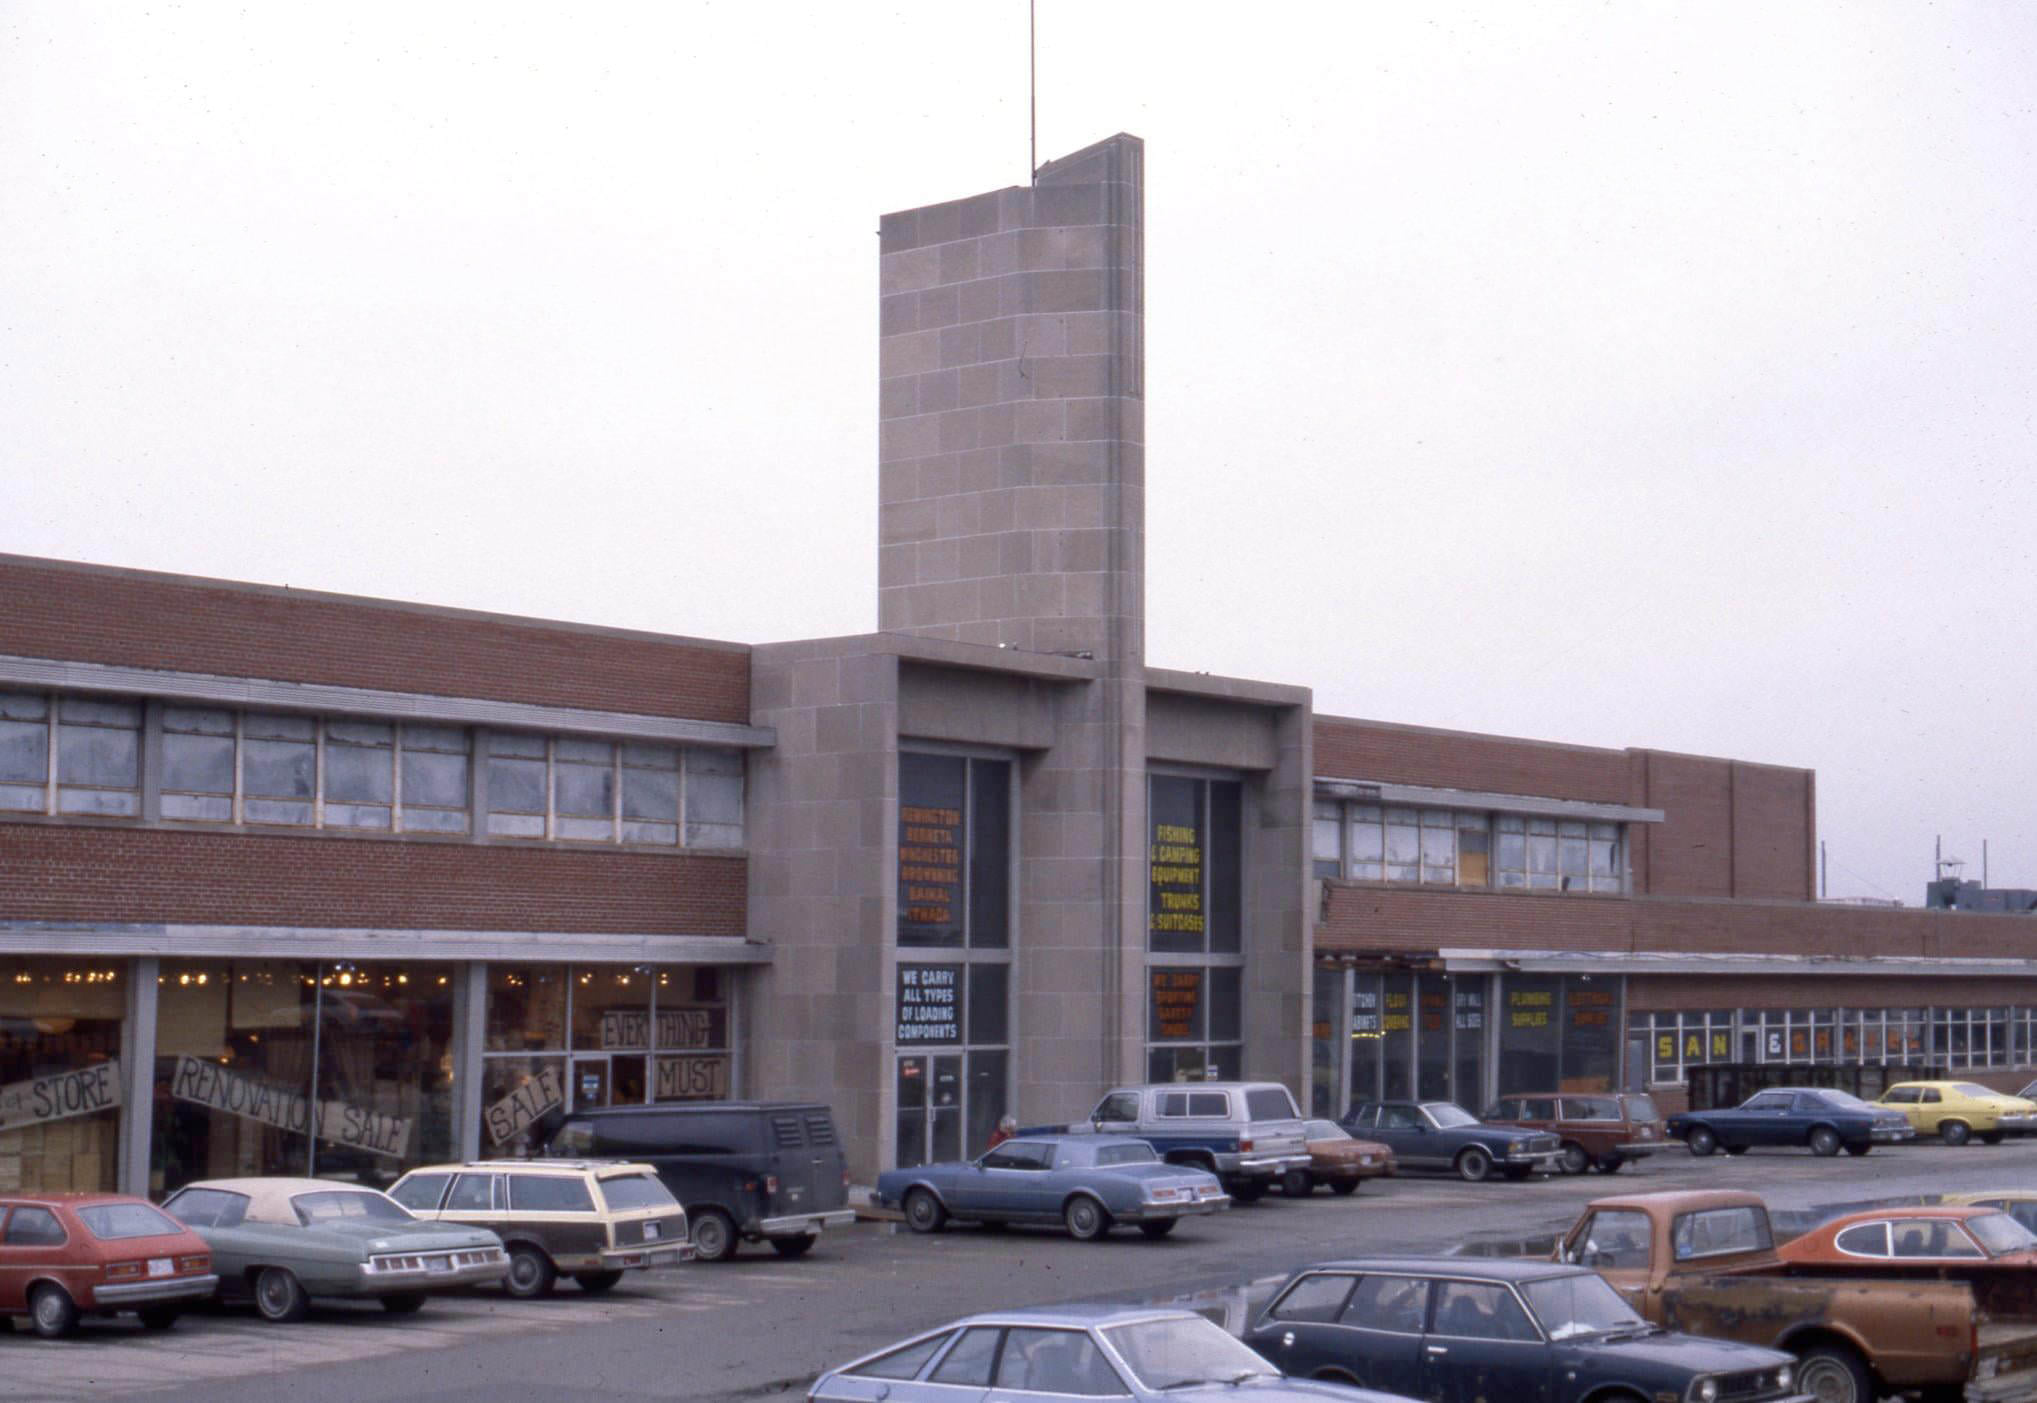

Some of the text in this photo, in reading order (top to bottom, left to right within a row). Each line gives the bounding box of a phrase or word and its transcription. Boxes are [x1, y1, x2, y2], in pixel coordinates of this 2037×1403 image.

[1157, 824, 1195, 844] FISHING
[1160, 845, 1200, 865] CAMPING
[1161, 892, 1200, 910] TRUNKS
[903, 970, 954, 985] WE CARRY
[904, 989, 953, 1002] ALL TYPES
[903, 1007, 953, 1021] OF LOADING
[898, 1024, 957, 1039] COMPONENTS
[656, 1060, 720, 1097] MUST
[32, 1065, 113, 1119] STORE
[175, 1055, 403, 1154] RENOVATION SALE
[489, 1069, 562, 1142] SALE
